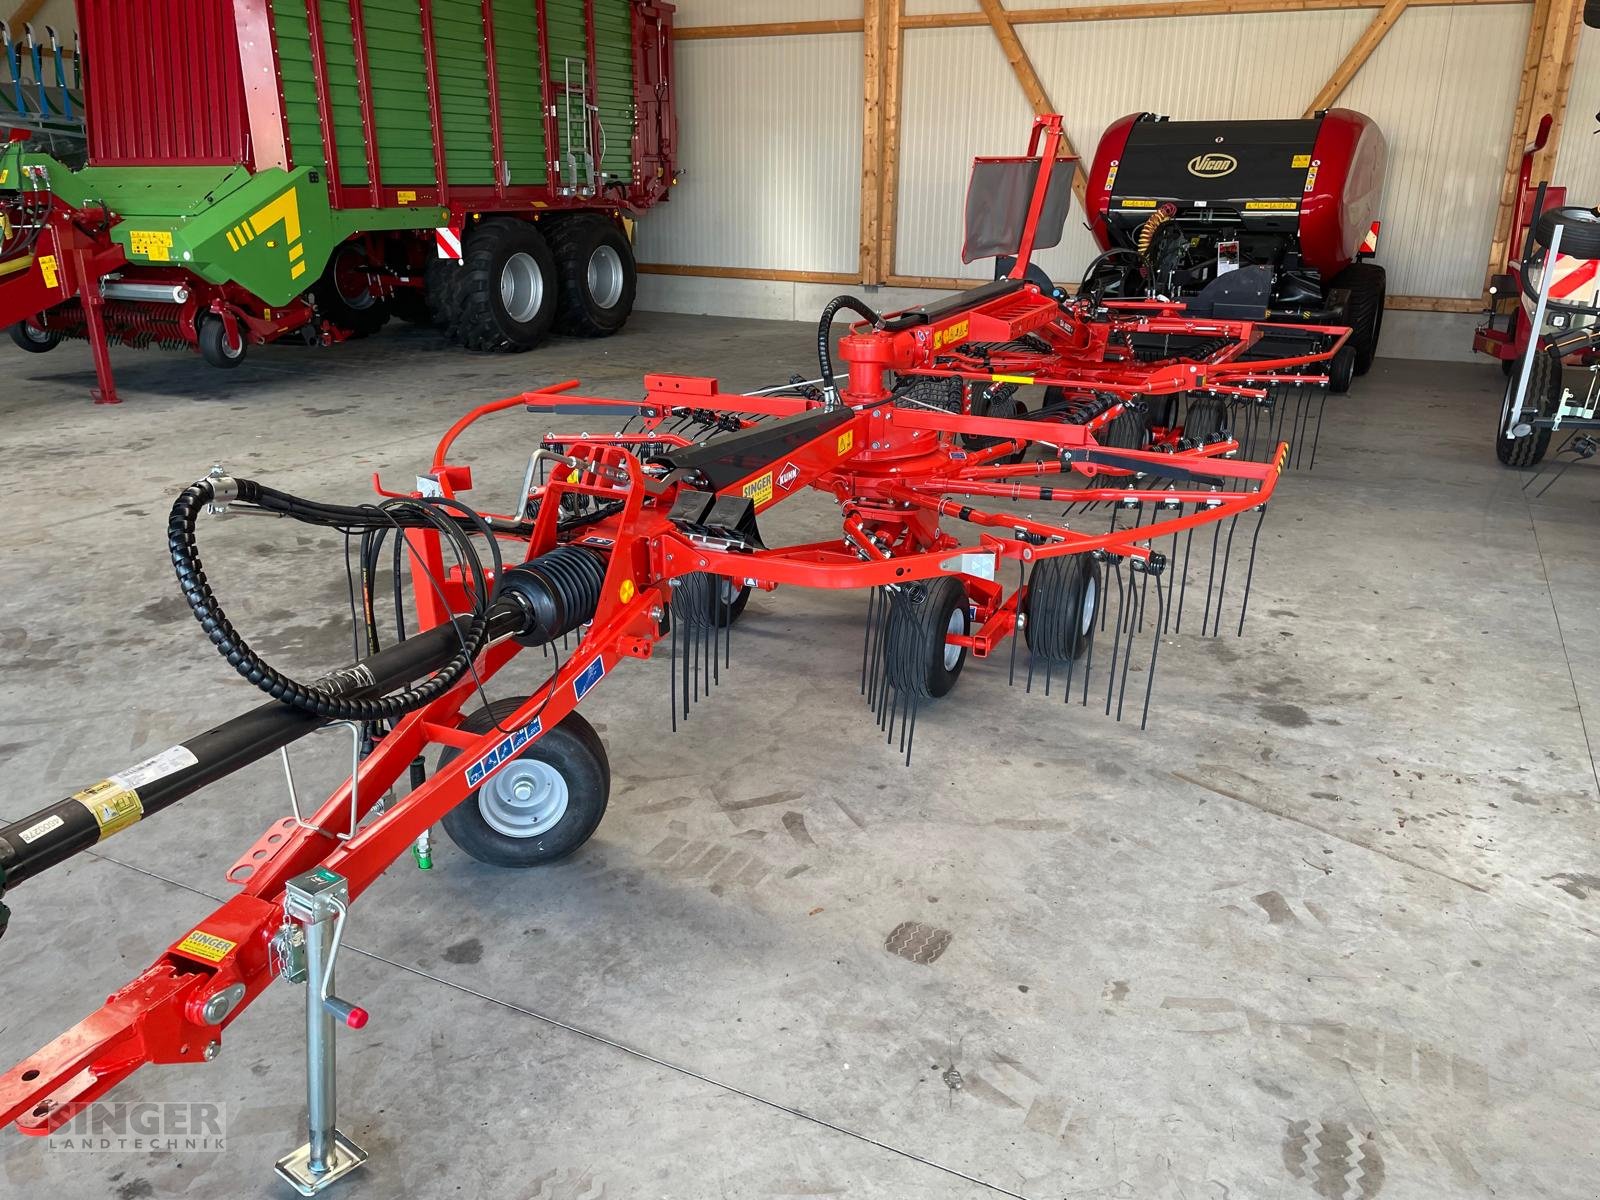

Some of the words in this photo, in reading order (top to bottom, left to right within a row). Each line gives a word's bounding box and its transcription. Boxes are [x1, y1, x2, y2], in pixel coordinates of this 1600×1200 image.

[1192, 154, 1233, 172] Vicon
[744, 474, 772, 496] SINGER
[779, 468, 798, 486] KUHN
[191, 932, 233, 952] SINGER
